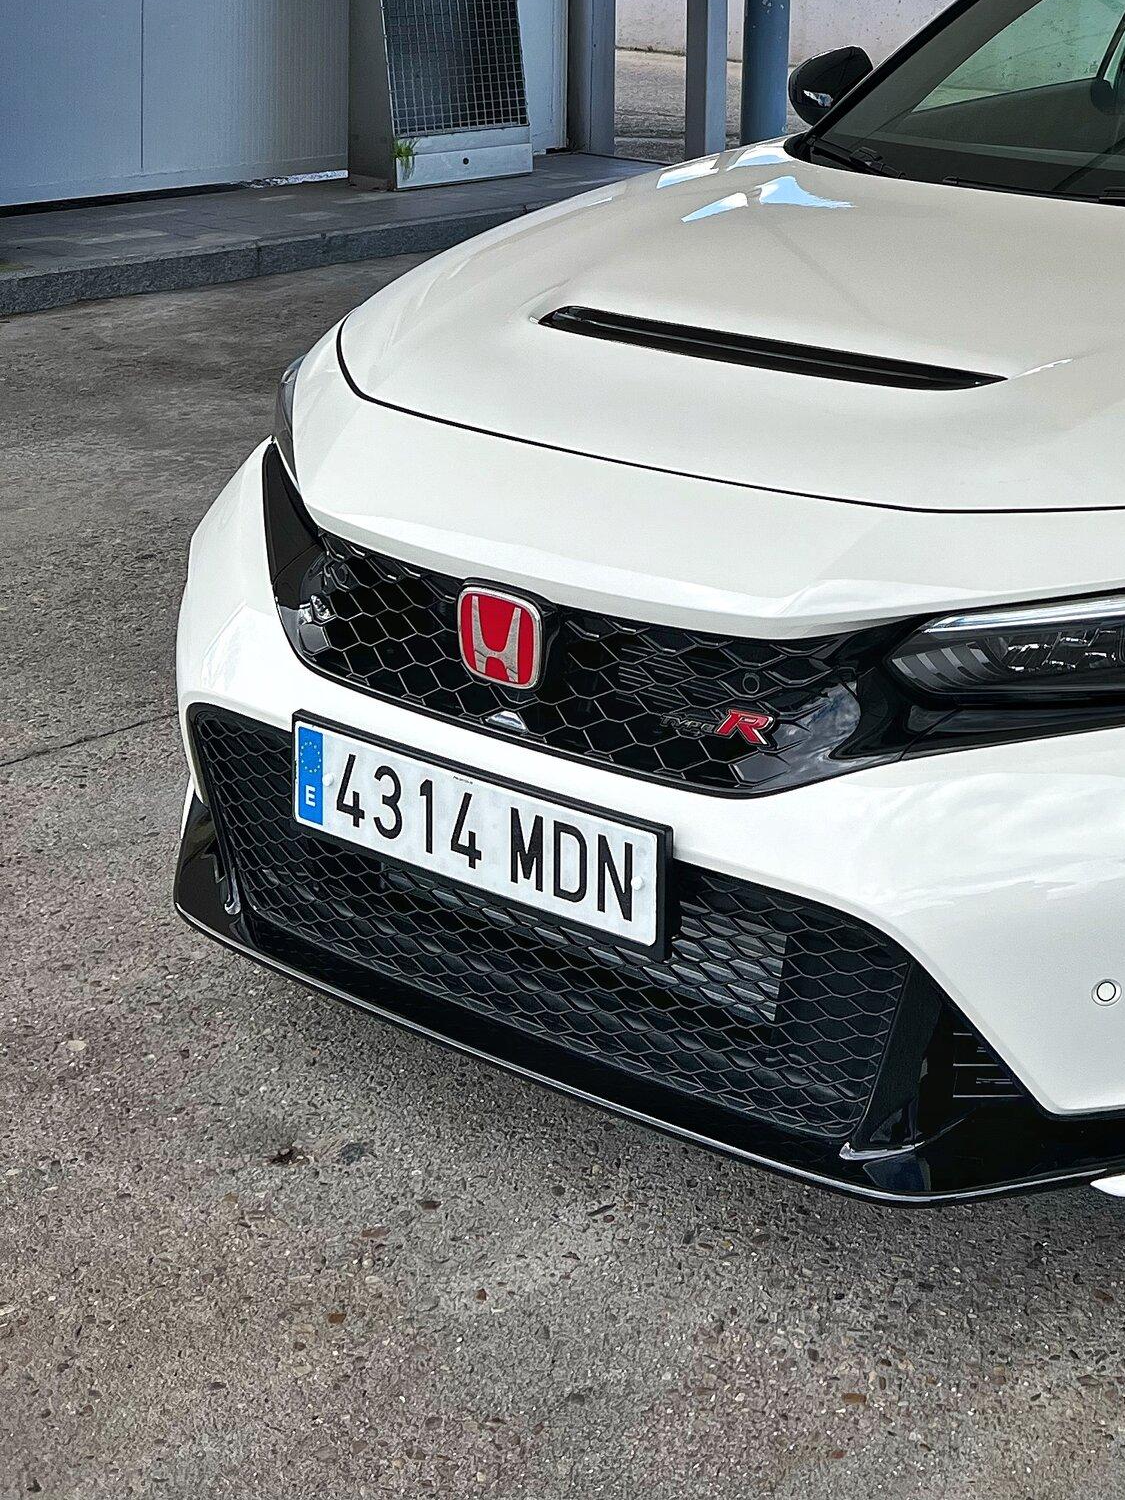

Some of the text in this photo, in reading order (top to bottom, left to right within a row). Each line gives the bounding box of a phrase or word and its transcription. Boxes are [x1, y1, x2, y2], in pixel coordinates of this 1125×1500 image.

[714, 709, 775, 746] R
[305, 784, 316, 807] E
[336, 754, 633, 922] 4314 MDN
